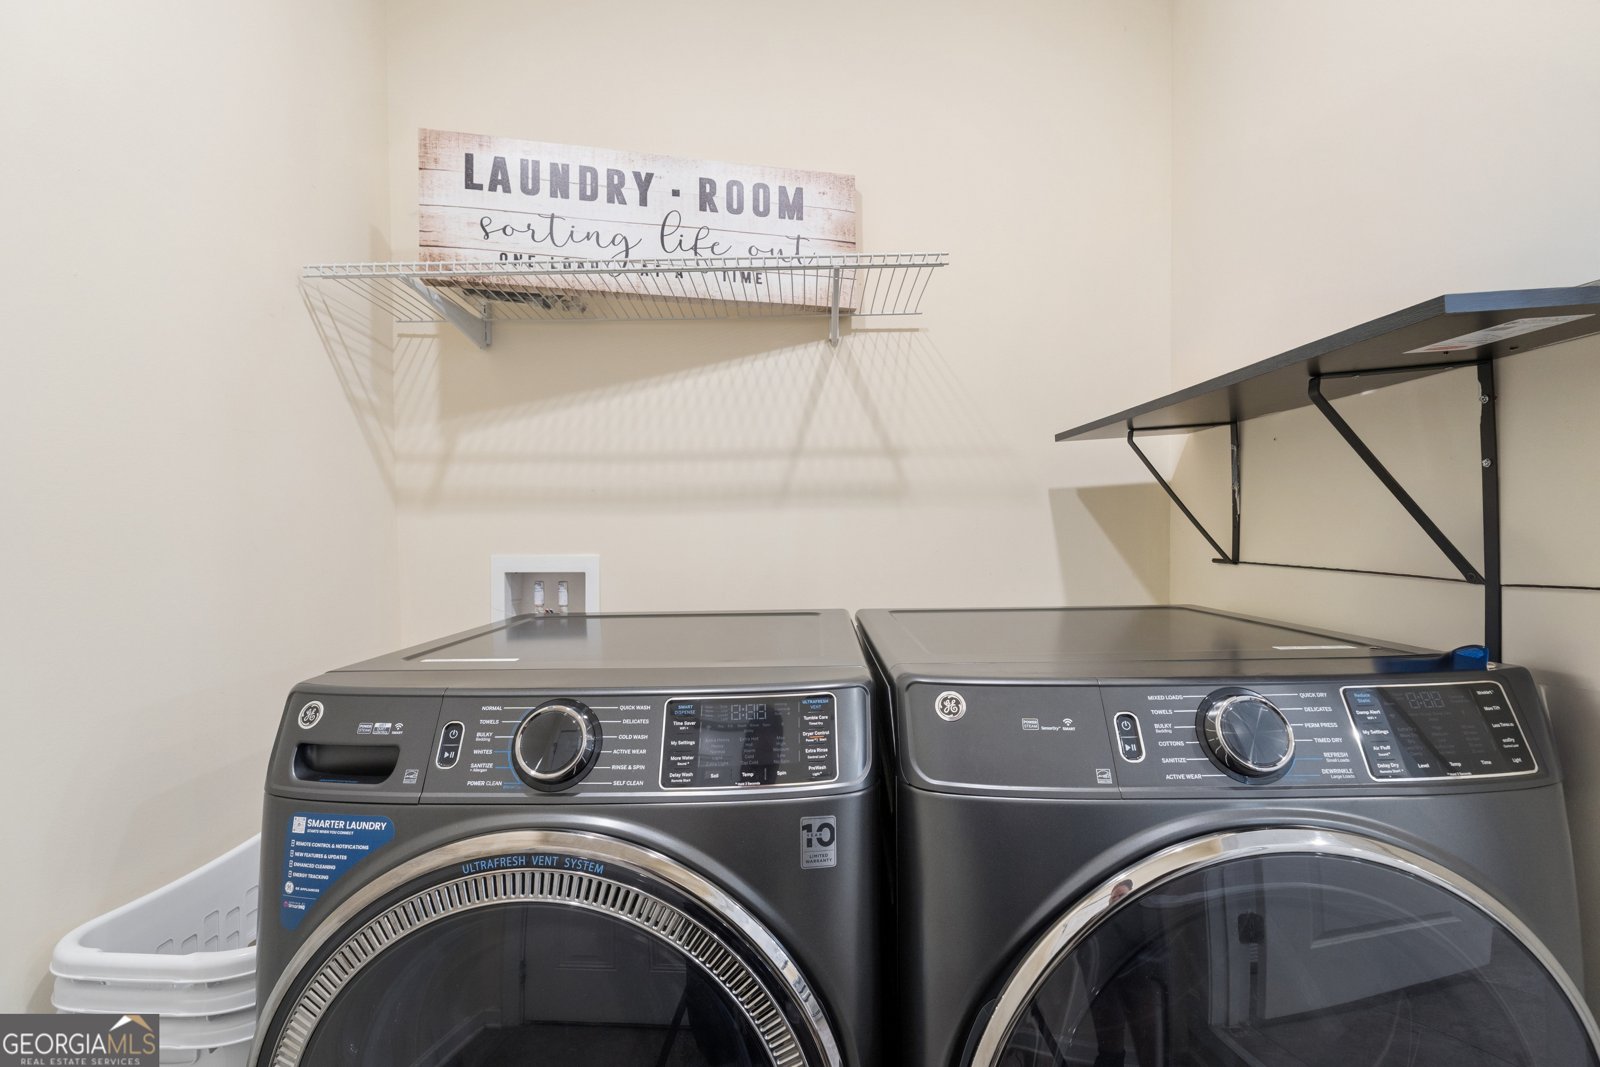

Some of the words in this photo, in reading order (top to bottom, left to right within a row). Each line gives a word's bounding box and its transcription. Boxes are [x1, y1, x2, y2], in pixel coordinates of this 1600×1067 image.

[464, 153, 654, 207] LAUNDRY
[699, 177, 804, 221] ROOM
[480, 213, 642, 277] sorting
[660, 210, 733, 273] life
[748, 235, 815, 265] out
[499, 252, 535, 268] ONE
[723, 271, 763, 285] TIME
[307, 819, 345, 829] SMARTER
[346, 821, 387, 830] LAUNDRY
[801, 822, 835, 848] 10
[462, 856, 526, 874] ULTRAFRESH
[531, 855, 559, 866] VENT
[564, 857, 604, 874] SYSTEM
